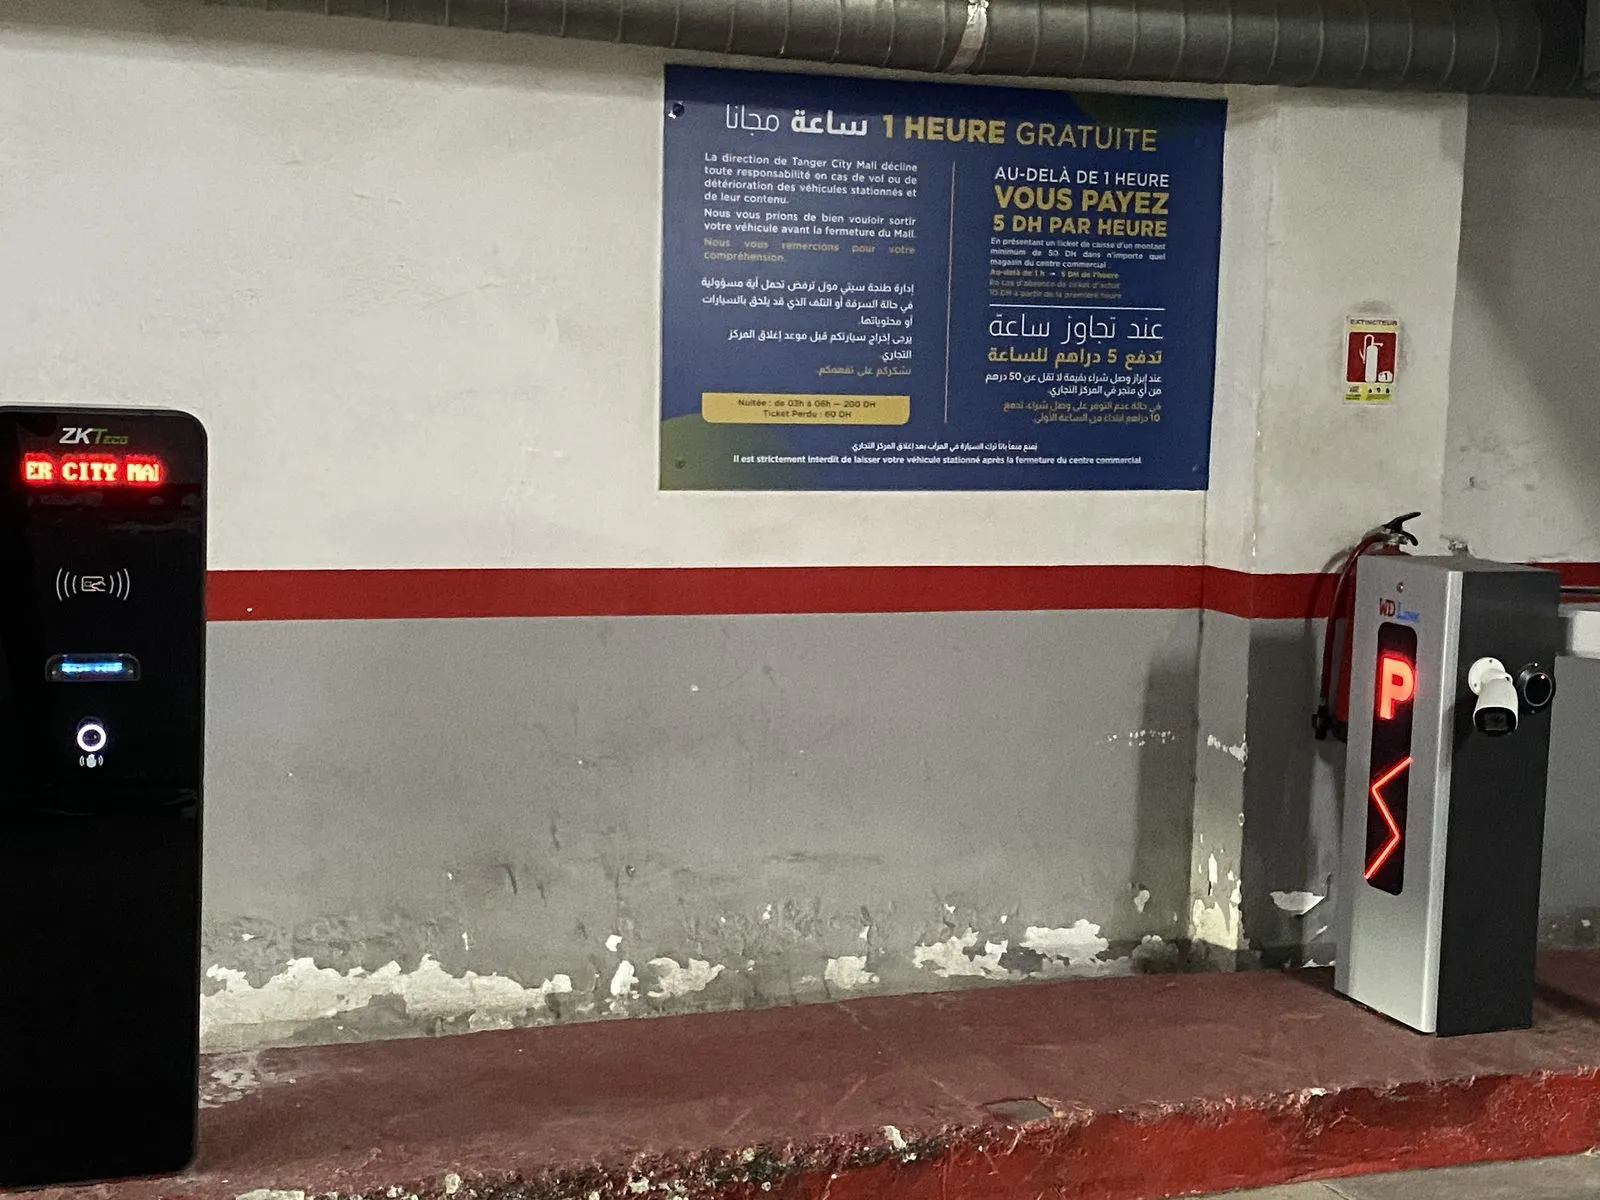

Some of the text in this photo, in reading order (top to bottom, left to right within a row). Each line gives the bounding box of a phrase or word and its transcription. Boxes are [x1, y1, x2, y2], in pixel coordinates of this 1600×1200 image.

[726, 104, 867, 137] ساعة مجانا
[882, 114, 1156, 151] 1 HEURE GRATUITE
[704, 152, 917, 171] La direction de Tanger City Mall décline
[704, 166, 732, 175] toute
[736, 167, 810, 180] responsabilité
[814, 172, 827, 180] en
[831, 173, 847, 181] cas
[852, 172, 864, 182] de
[868, 173, 883, 182] vol
[904, 175, 916, 184] de
[994, 162, 1070, 183] AU-DELÀ
[1076, 170, 1098, 184] DE
[1115, 171, 1168, 187] HEURE
[704, 177, 916, 197] détérioration des véhicules stationnés et
[704, 191, 717, 200] de
[720, 192, 740, 201] leur
[993, 184, 1169, 214] VOUS PAYEZ
[704, 208, 915, 225] Nous vous prions de bien vouloir sortir
[993, 214, 1167, 237] 5 DH PAR HEURE
[703, 221, 731, 230] votre
[734, 221, 778, 232] véhicule
[781, 225, 809, 234] avant
[813, 225, 821, 234] la
[825, 225, 874, 236] fermeture
[878, 228, 890, 237] du
[701, 276, 743, 289] مسؤولية
[760, 279, 784, 291] تحمل
[787, 280, 815, 292] ترفض
[817, 281, 837, 292] مول
[840, 282, 865, 295] سيتي
[867, 283, 891, 292] طنجة
[894, 283, 913, 295] إدارة
[989, 312, 1163, 345] عند تجاوز ساعة
[987, 346, 1161, 370] تدفع 5 دراهم للساعة
[756, 455, 805, 463] strictement
[807, 455, 839, 463] interdit
[840, 455, 851, 463] de
[853, 455, 880, 463] laisser
[906, 455, 940, 463] véhicule
[982, 456, 1004, 464] après
[26, 461, 52, 480] ER
[62, 462, 117, 481] CITY
[1379, 656, 1414, 720] P
